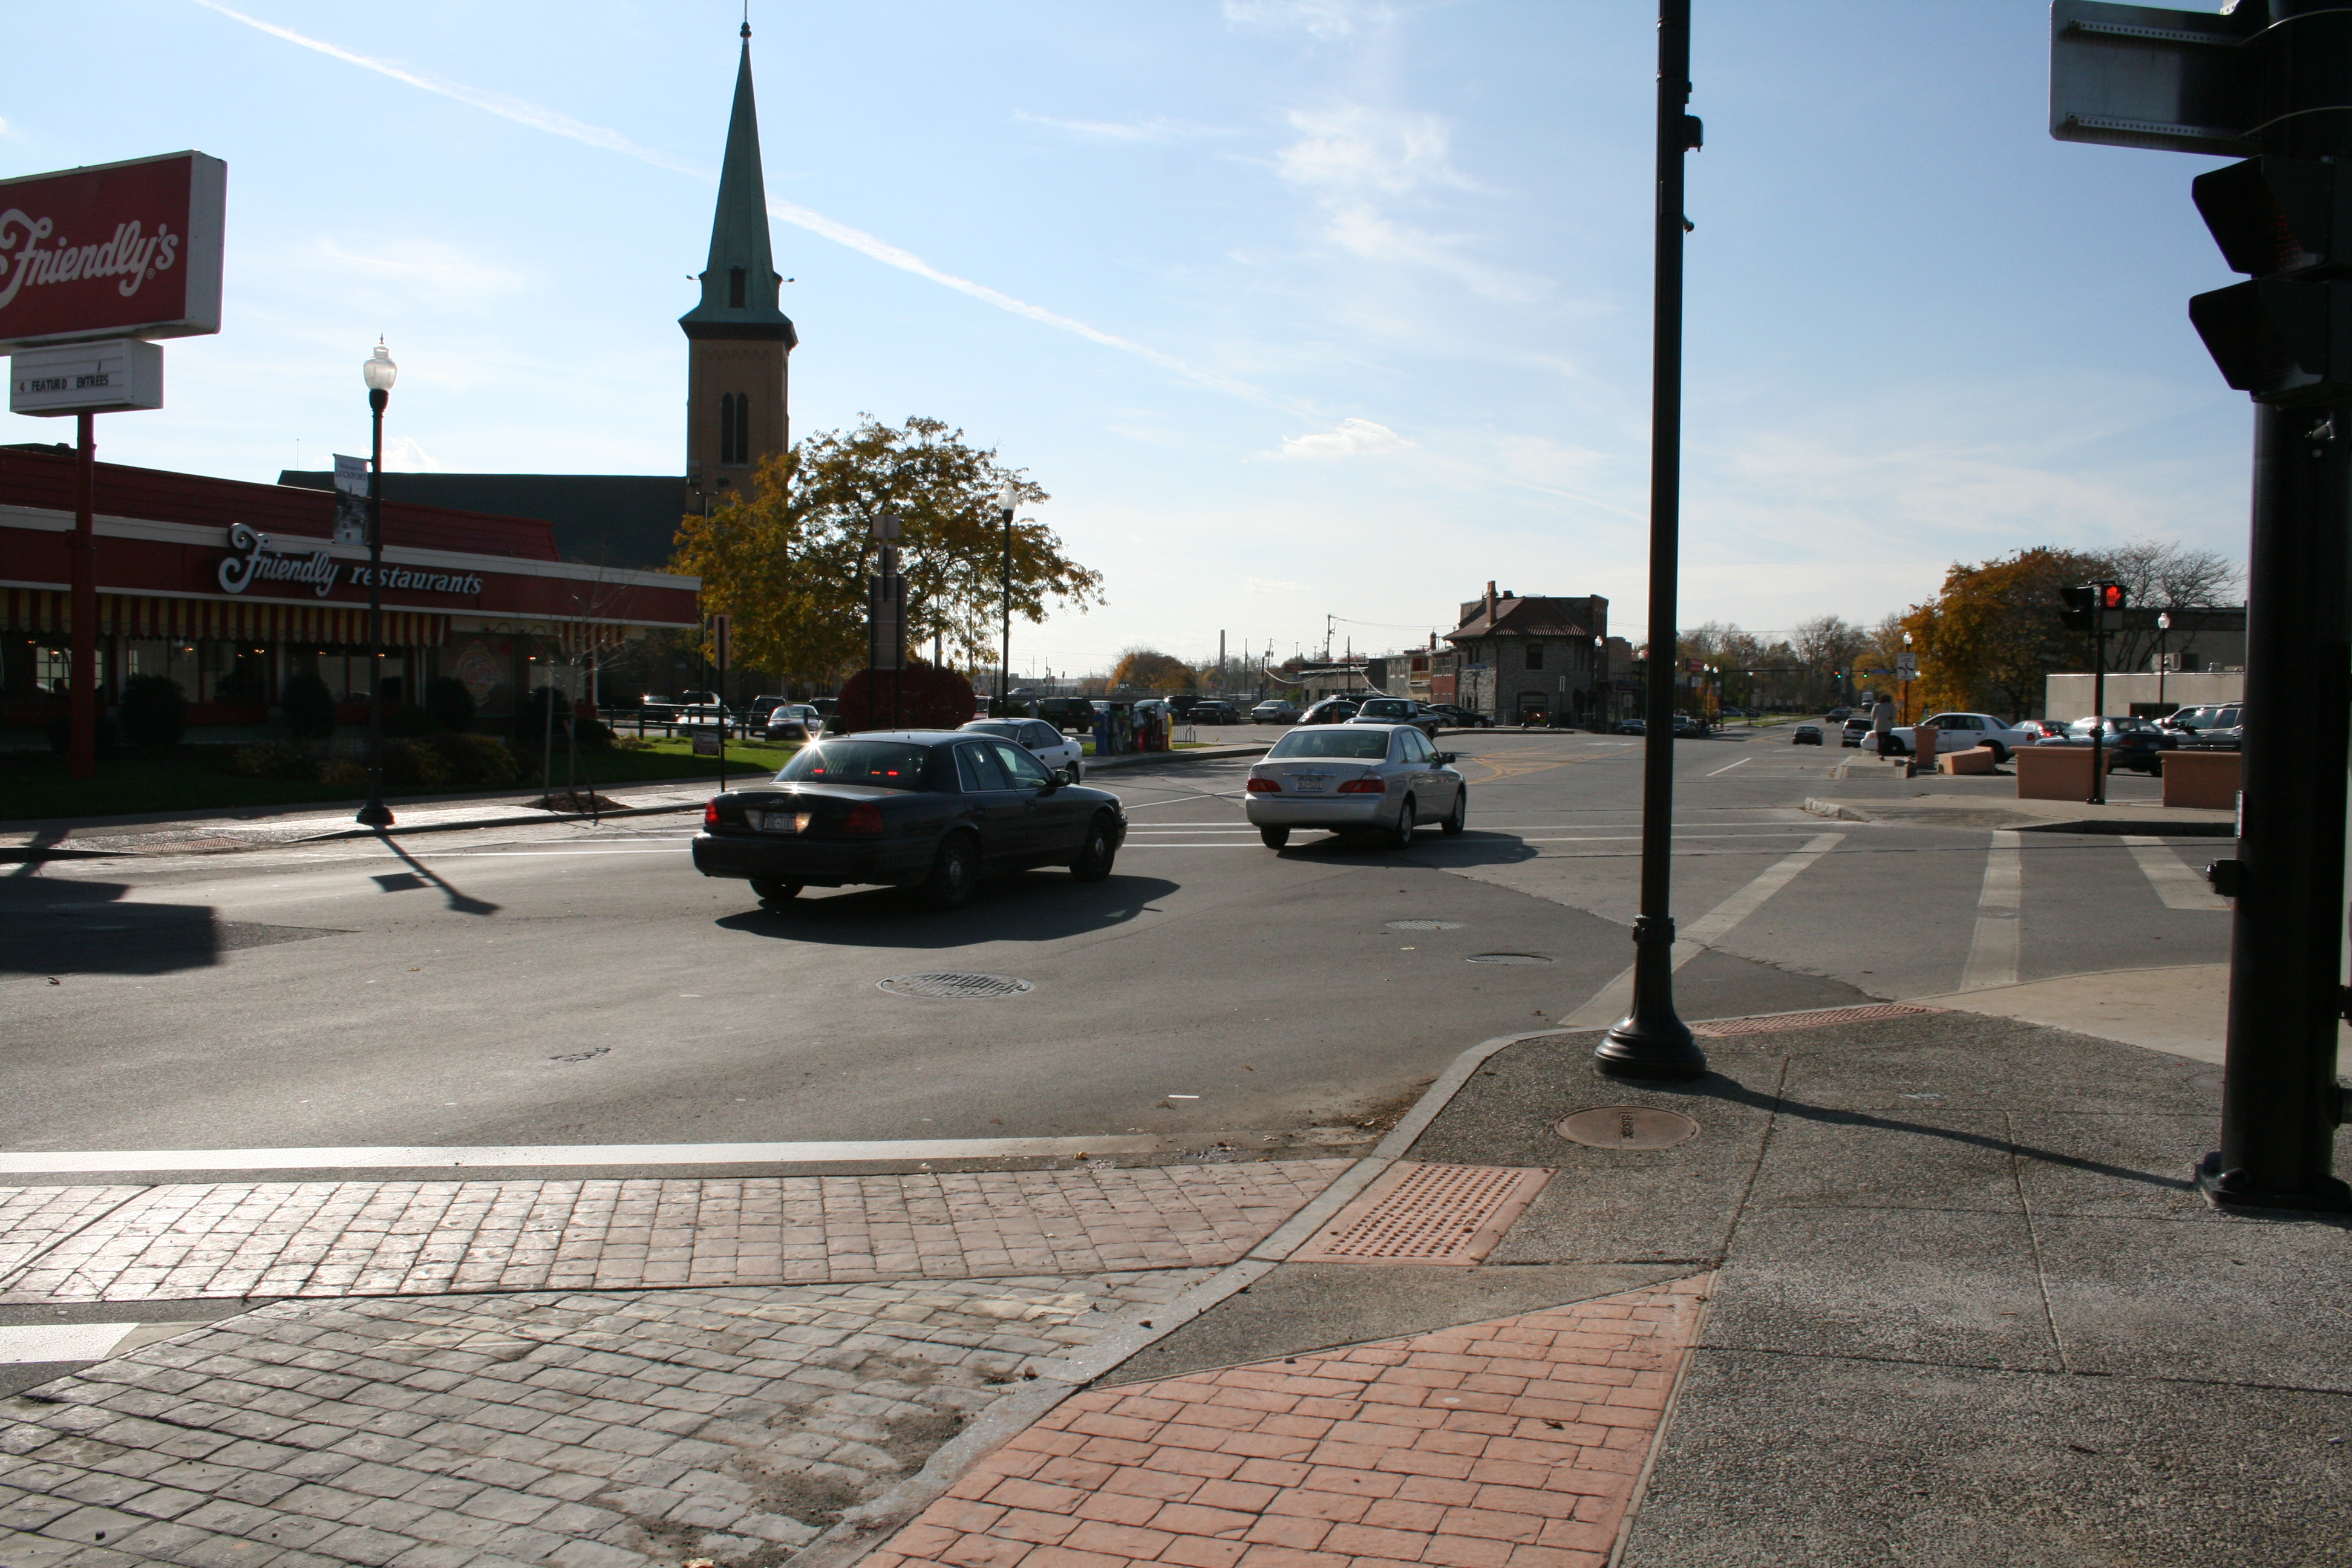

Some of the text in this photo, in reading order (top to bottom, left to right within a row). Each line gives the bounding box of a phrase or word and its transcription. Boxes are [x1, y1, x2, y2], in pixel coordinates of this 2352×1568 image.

[0, 209, 178, 309] Friendly's
[20, 382, 25, 392] 4
[77, 375, 109, 388] ENTREES
[335, 469, 366, 481] LOCKPORT
[219, 523, 483, 597] Friendly restaurants
